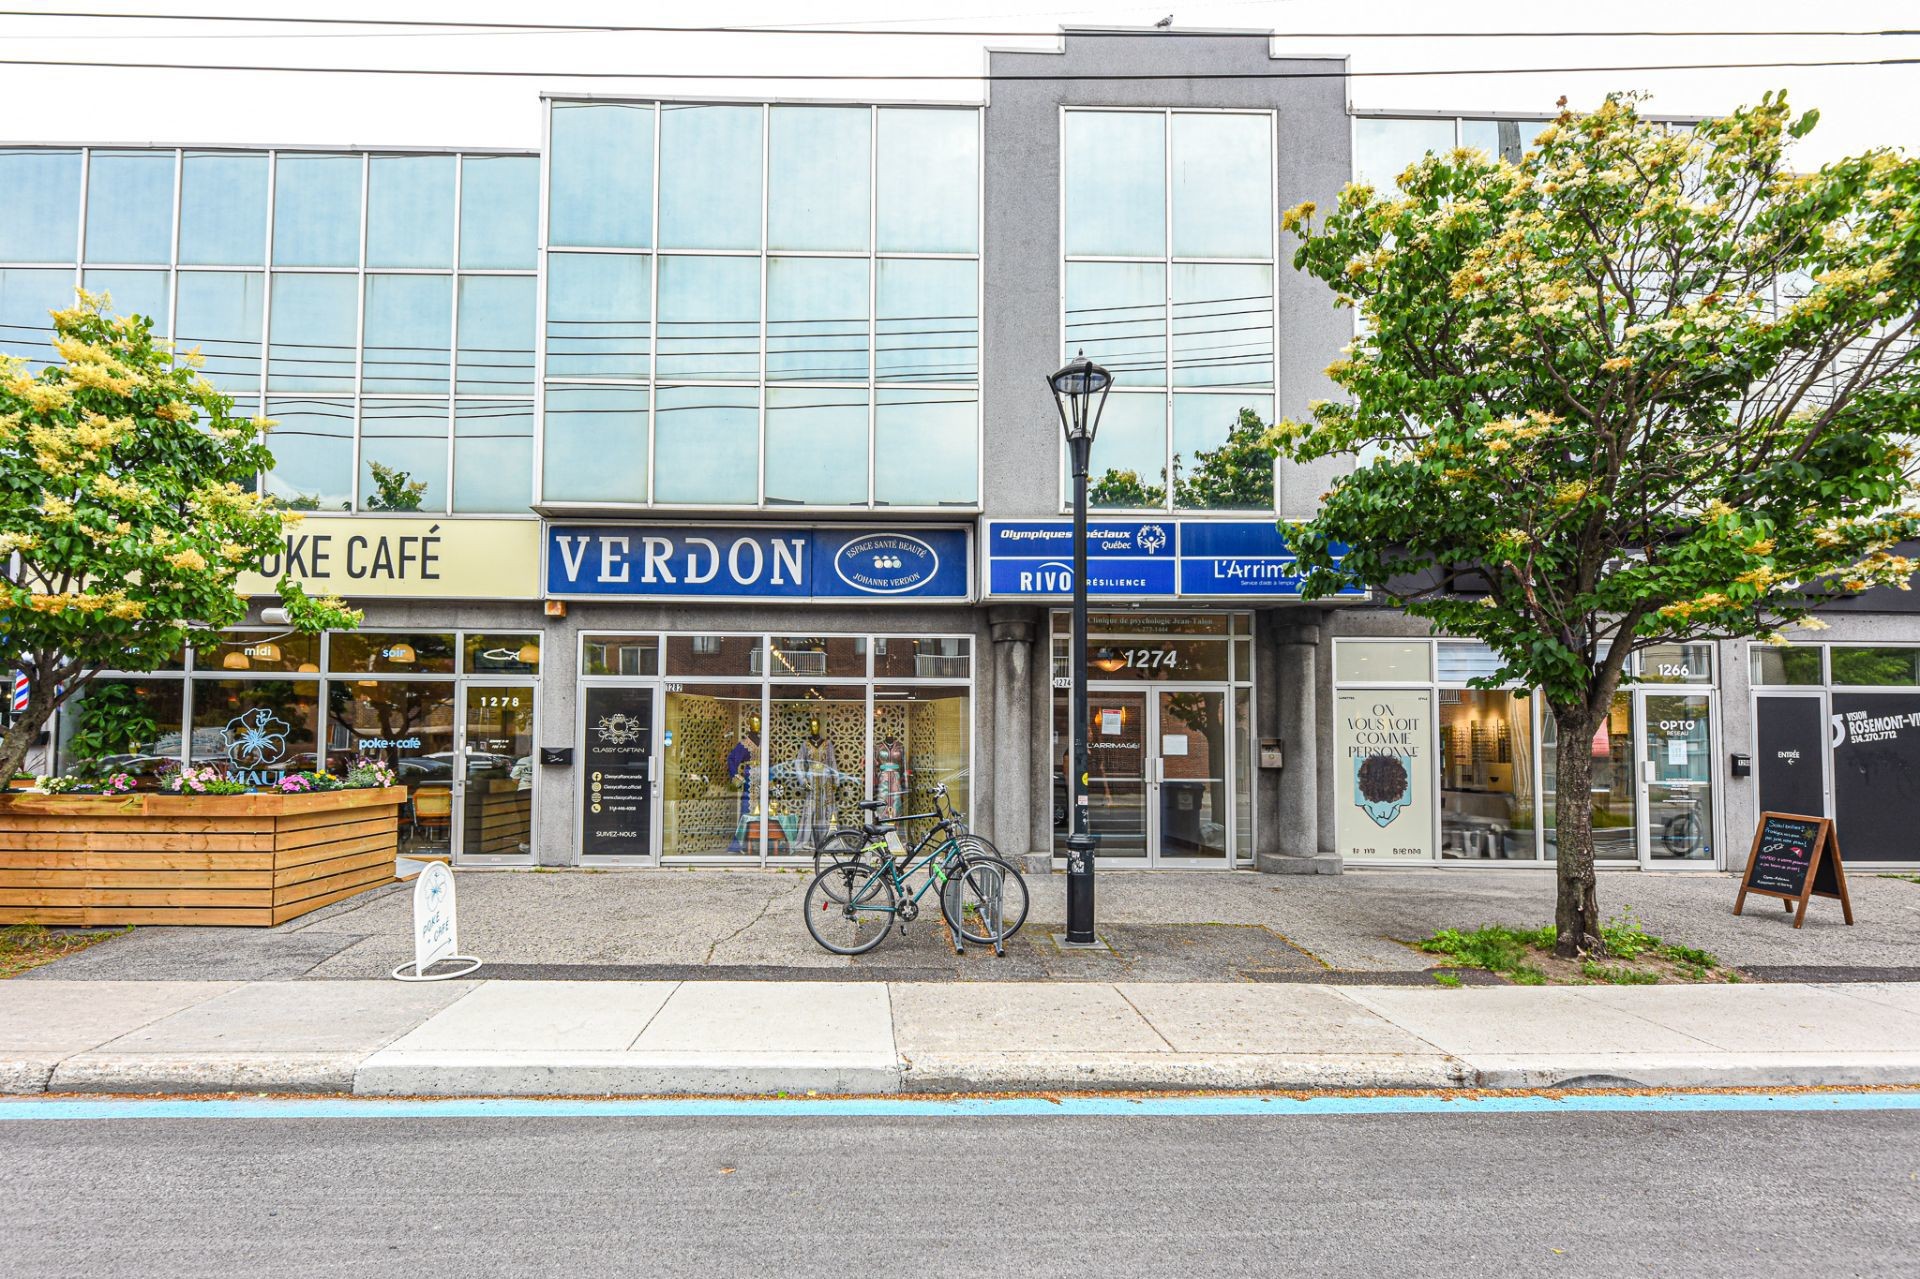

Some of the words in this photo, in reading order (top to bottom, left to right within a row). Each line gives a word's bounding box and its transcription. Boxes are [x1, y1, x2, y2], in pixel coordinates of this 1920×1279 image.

[1000, 529, 1074, 539] Olympiques
[1086, 529, 1131, 539] éciaux
[259, 535, 332, 578] OKE
[346, 523, 441, 580] CAFÉ
[846, 541, 874, 559] ESPACE
[874, 539, 897, 549] SANTÉ
[898, 541, 928, 558] BEAUTÉ
[1101, 541, 1132, 550] Québec
[555, 536, 805, 585] VERDON
[852, 572, 889, 587] JOHANNE
[890, 572, 921, 587] VERDON
[1020, 571, 1072, 592] RIVO
[1086, 577, 1146, 587] RÉSILIENCE
[1119, 617, 1129, 625] de
[244, 646, 272, 656] midi
[382, 649, 406, 658] soir
[1124, 650, 1177, 668] 1274
[1657, 664, 1689, 676] 1266
[1055, 678, 1071, 687] 1274
[480, 696, 520, 707] 1278
[1372, 704, 1394, 716] ON
[1846, 710, 1868, 722] VISION
[1348, 718, 1385, 731] VOUS
[1388, 718, 1420, 731] VOIT
[1659, 720, 1695, 731] OPTO
[1356, 732, 1412, 744] COMME
[1850, 730, 1897, 744] 514.270.7712
[1348, 746, 1420, 758] PERSONNE
[1777, 750, 1800, 759] ENTRÉE
[226, 770, 286, 786] MAUI
